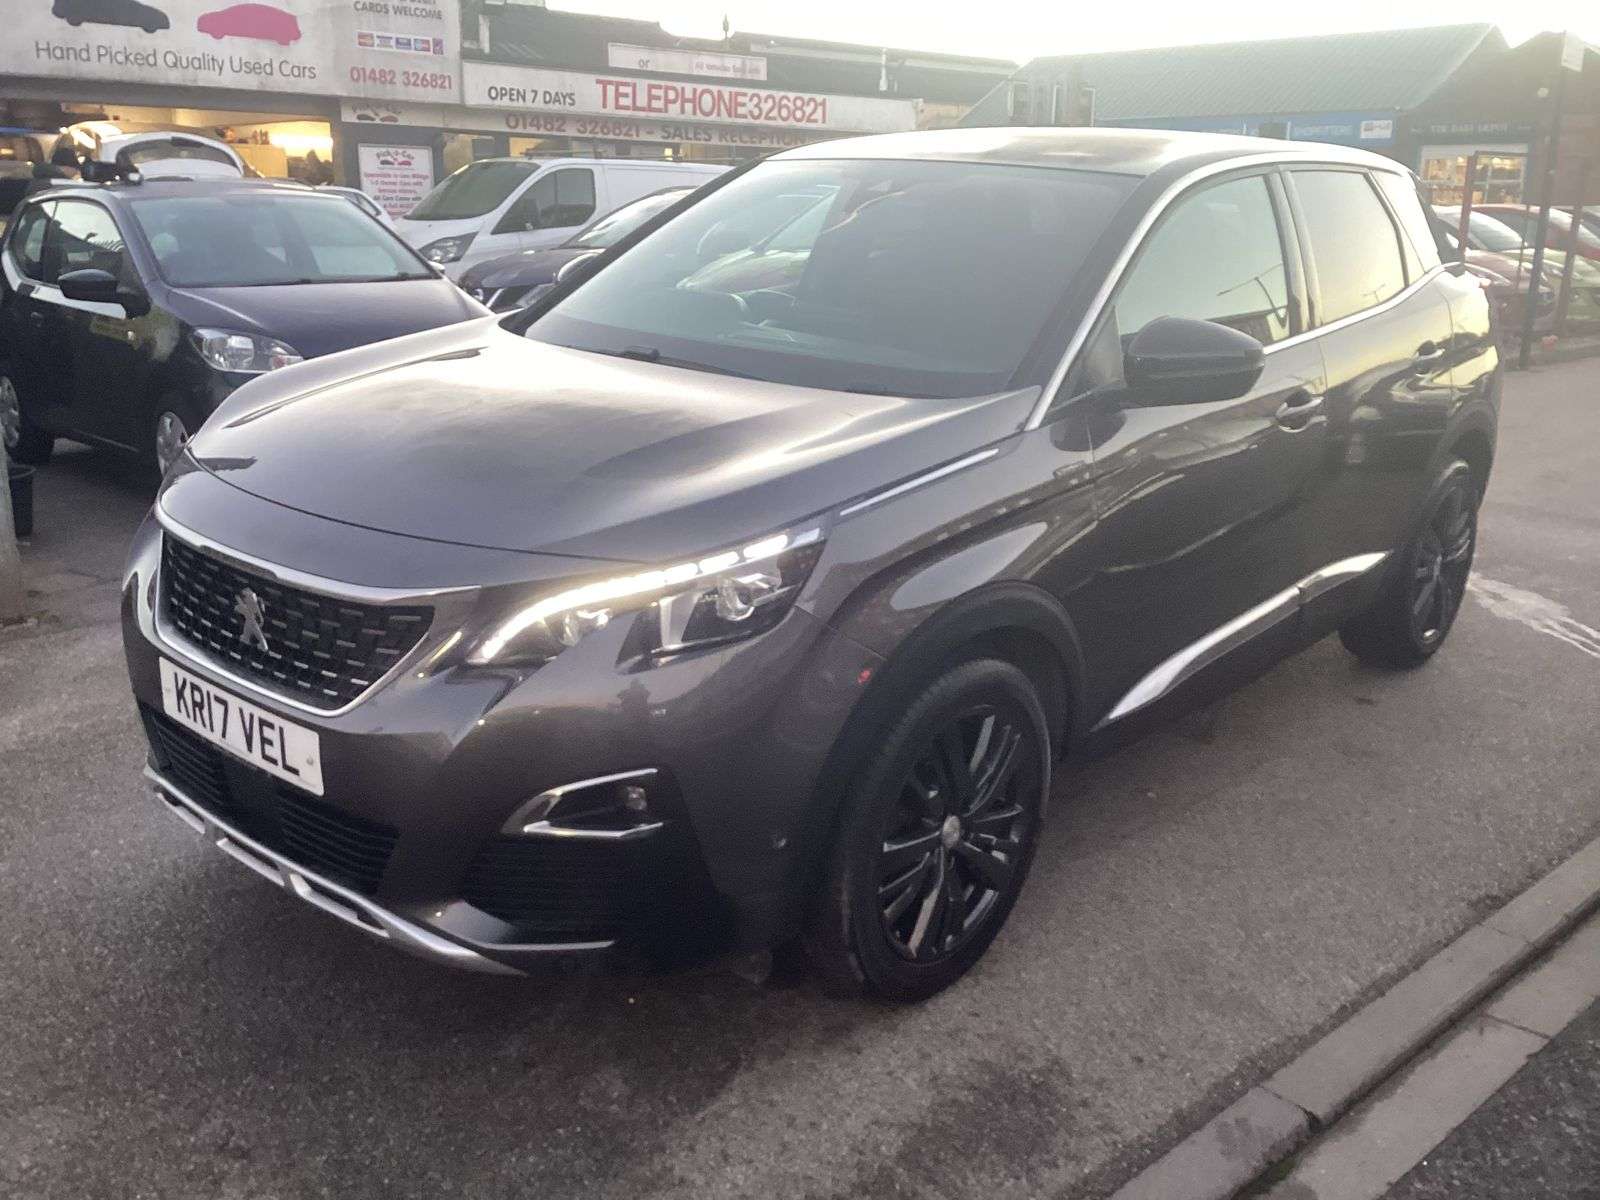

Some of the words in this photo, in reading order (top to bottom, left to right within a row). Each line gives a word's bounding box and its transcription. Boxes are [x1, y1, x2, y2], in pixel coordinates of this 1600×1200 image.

[353, 1, 390, 15] CARDS
[392, 5, 443, 20] WELCOME
[34, 40, 91, 63] Hand
[96, 44, 158, 68] Picked
[163, 50, 225, 77] Quality
[229, 55, 275, 77] Used
[278, 59, 317, 80] Cars
[349, 65, 397, 86] 01482
[401, 70, 453, 90] 326821
[487, 85, 527, 103] OPEN
[530, 89, 539, 104] 7
[542, 90, 577, 107] DAYS
[505, 113, 567, 133] 01482
[576, 118, 641, 138] 326821
[660, 124, 713, 143] SALES
[173, 671, 230, 740] KR17
[238, 705, 301, 777] VEL
